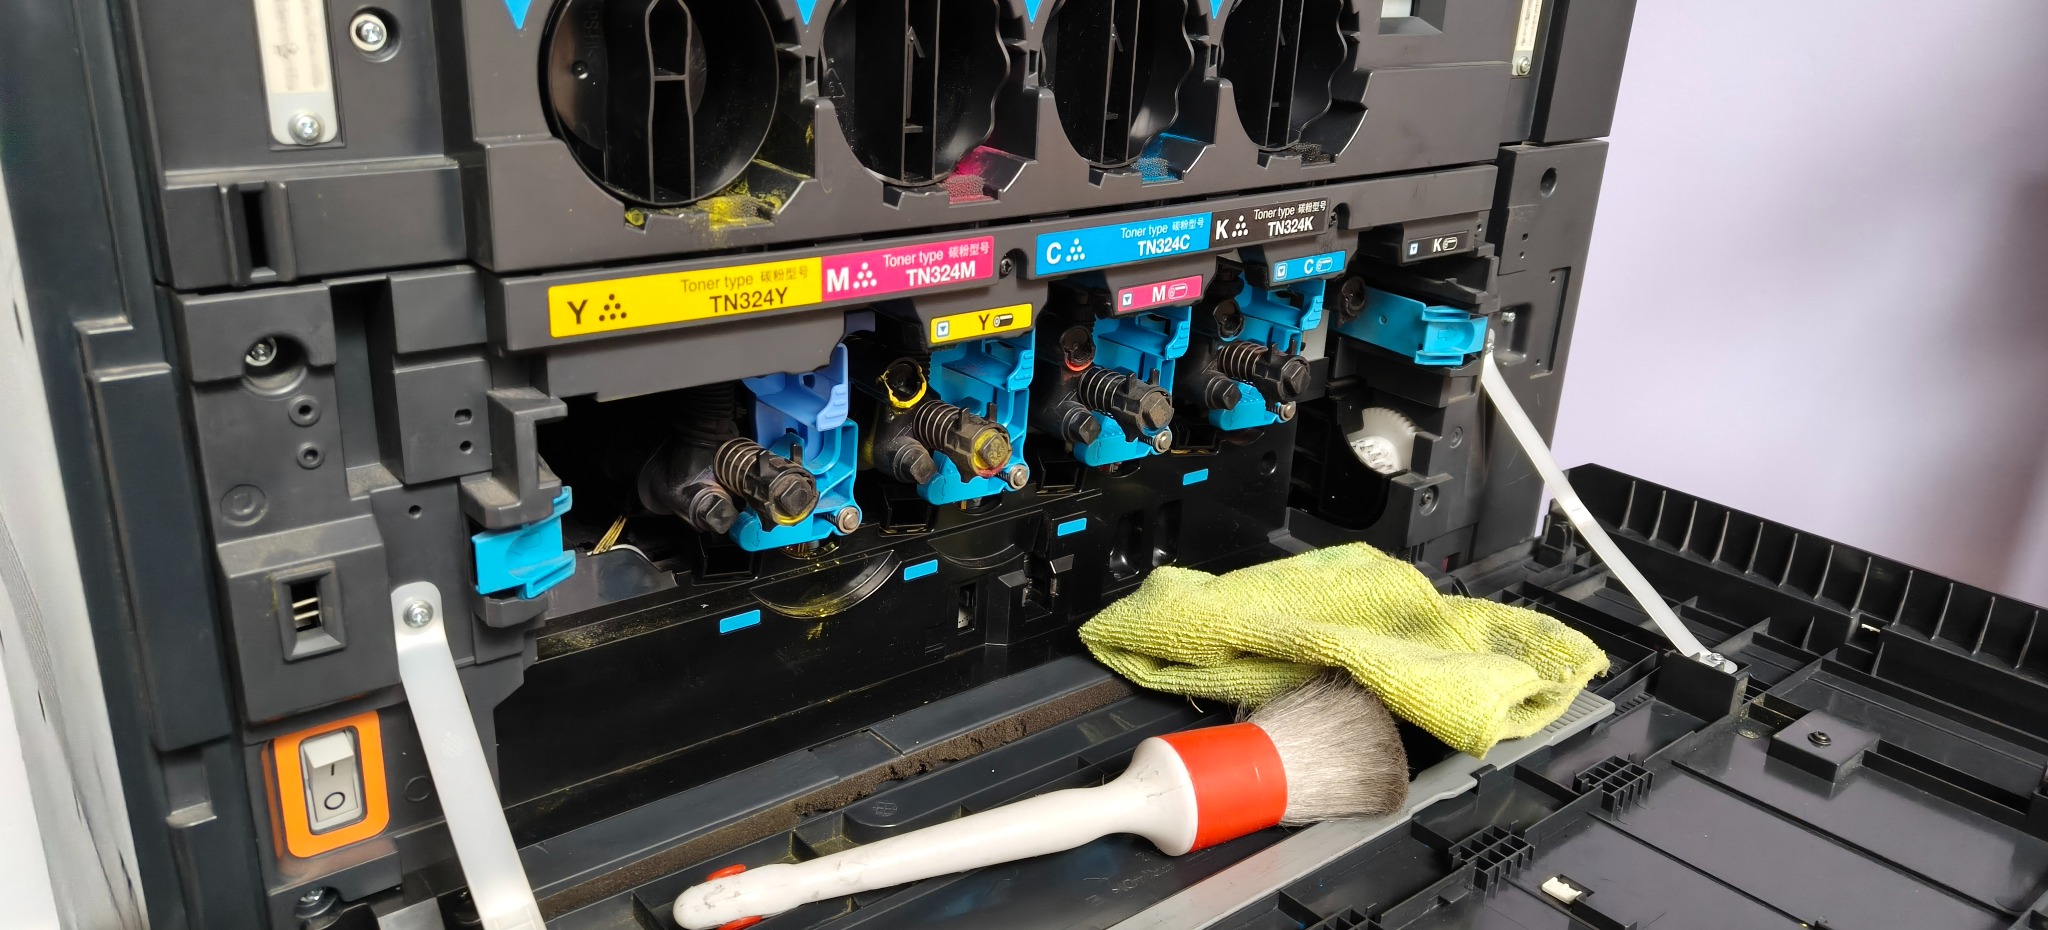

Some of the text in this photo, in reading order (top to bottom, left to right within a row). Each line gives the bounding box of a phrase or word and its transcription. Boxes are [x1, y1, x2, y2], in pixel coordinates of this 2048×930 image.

[1253, 200, 1326, 220] Toner type 碳粉型号
[1120, 217, 1204, 239] Toner type 碳粉型号
[1215, 218, 1230, 240] K
[1267, 216, 1314, 237] TN324K
[883, 241, 989, 268] Toner type 碳粉型号
[1046, 242, 1062, 264] C
[1137, 234, 1191, 256] TN324C
[1432, 237, 1443, 253] K
[906, 260, 976, 287] TN324M
[1303, 258, 1314, 274] C
[680, 266, 809, 293] Toner type 碳粉型号
[827, 267, 849, 292] M
[709, 287, 789, 313] TN324Y
[1151, 284, 1166, 303] M
[567, 299, 588, 325] Y
[978, 314, 990, 331] Y
